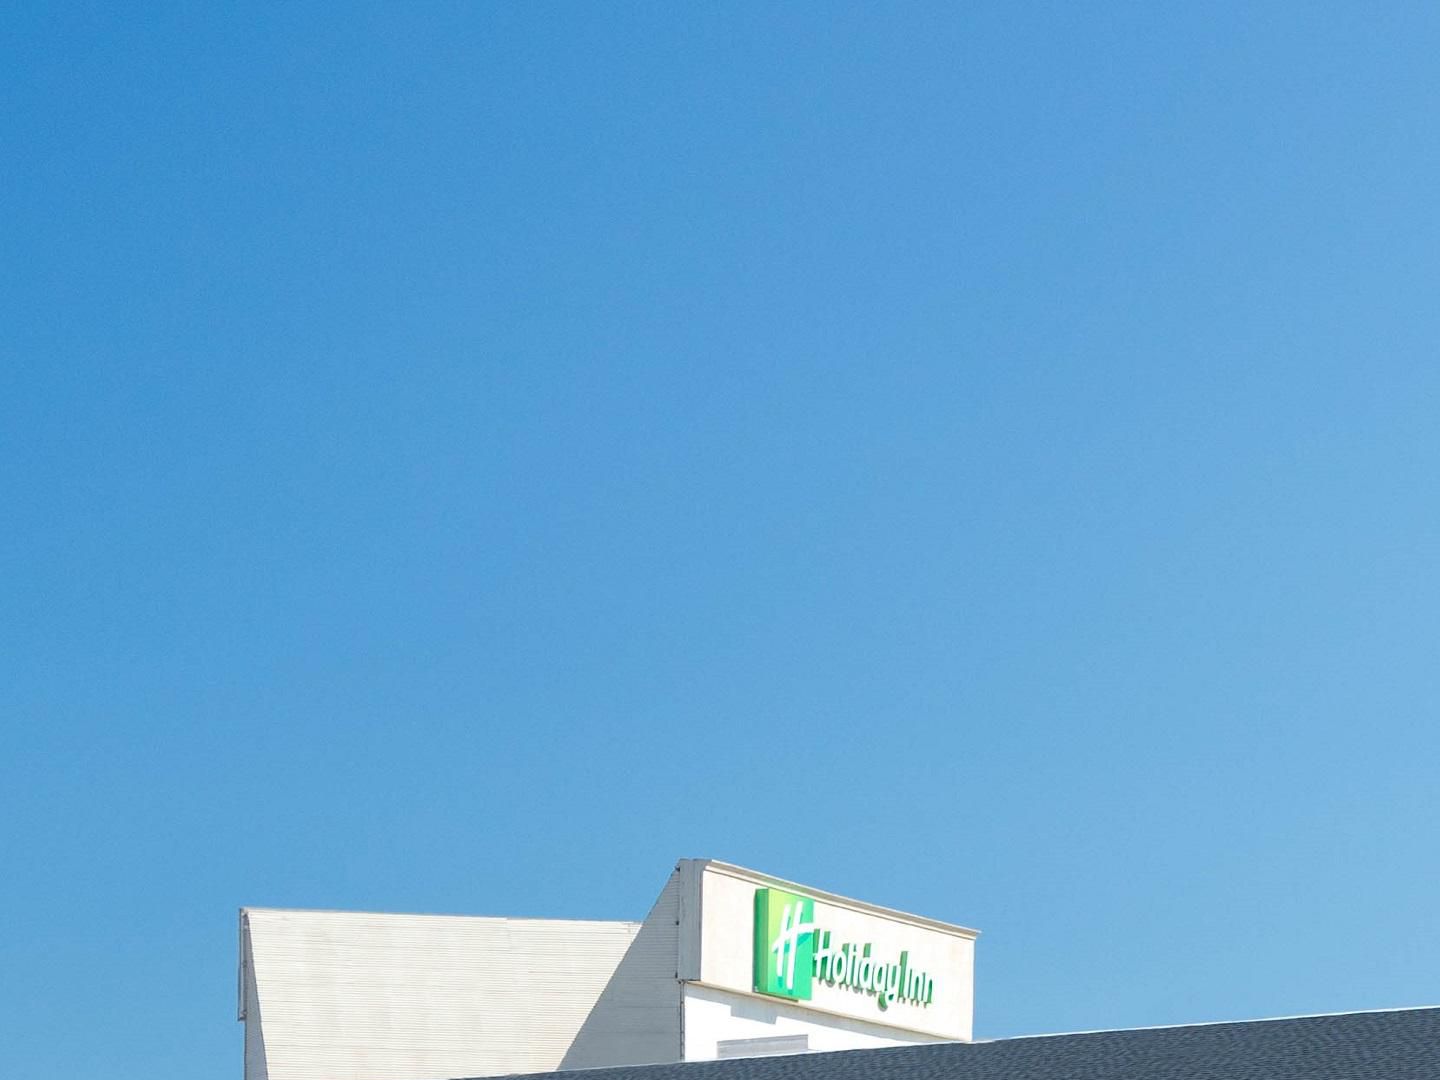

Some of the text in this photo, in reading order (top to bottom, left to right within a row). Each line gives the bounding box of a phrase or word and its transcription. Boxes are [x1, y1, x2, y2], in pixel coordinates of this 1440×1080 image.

[771, 900, 815, 991] H
[812, 927, 934, 1011] Holiday Inn
